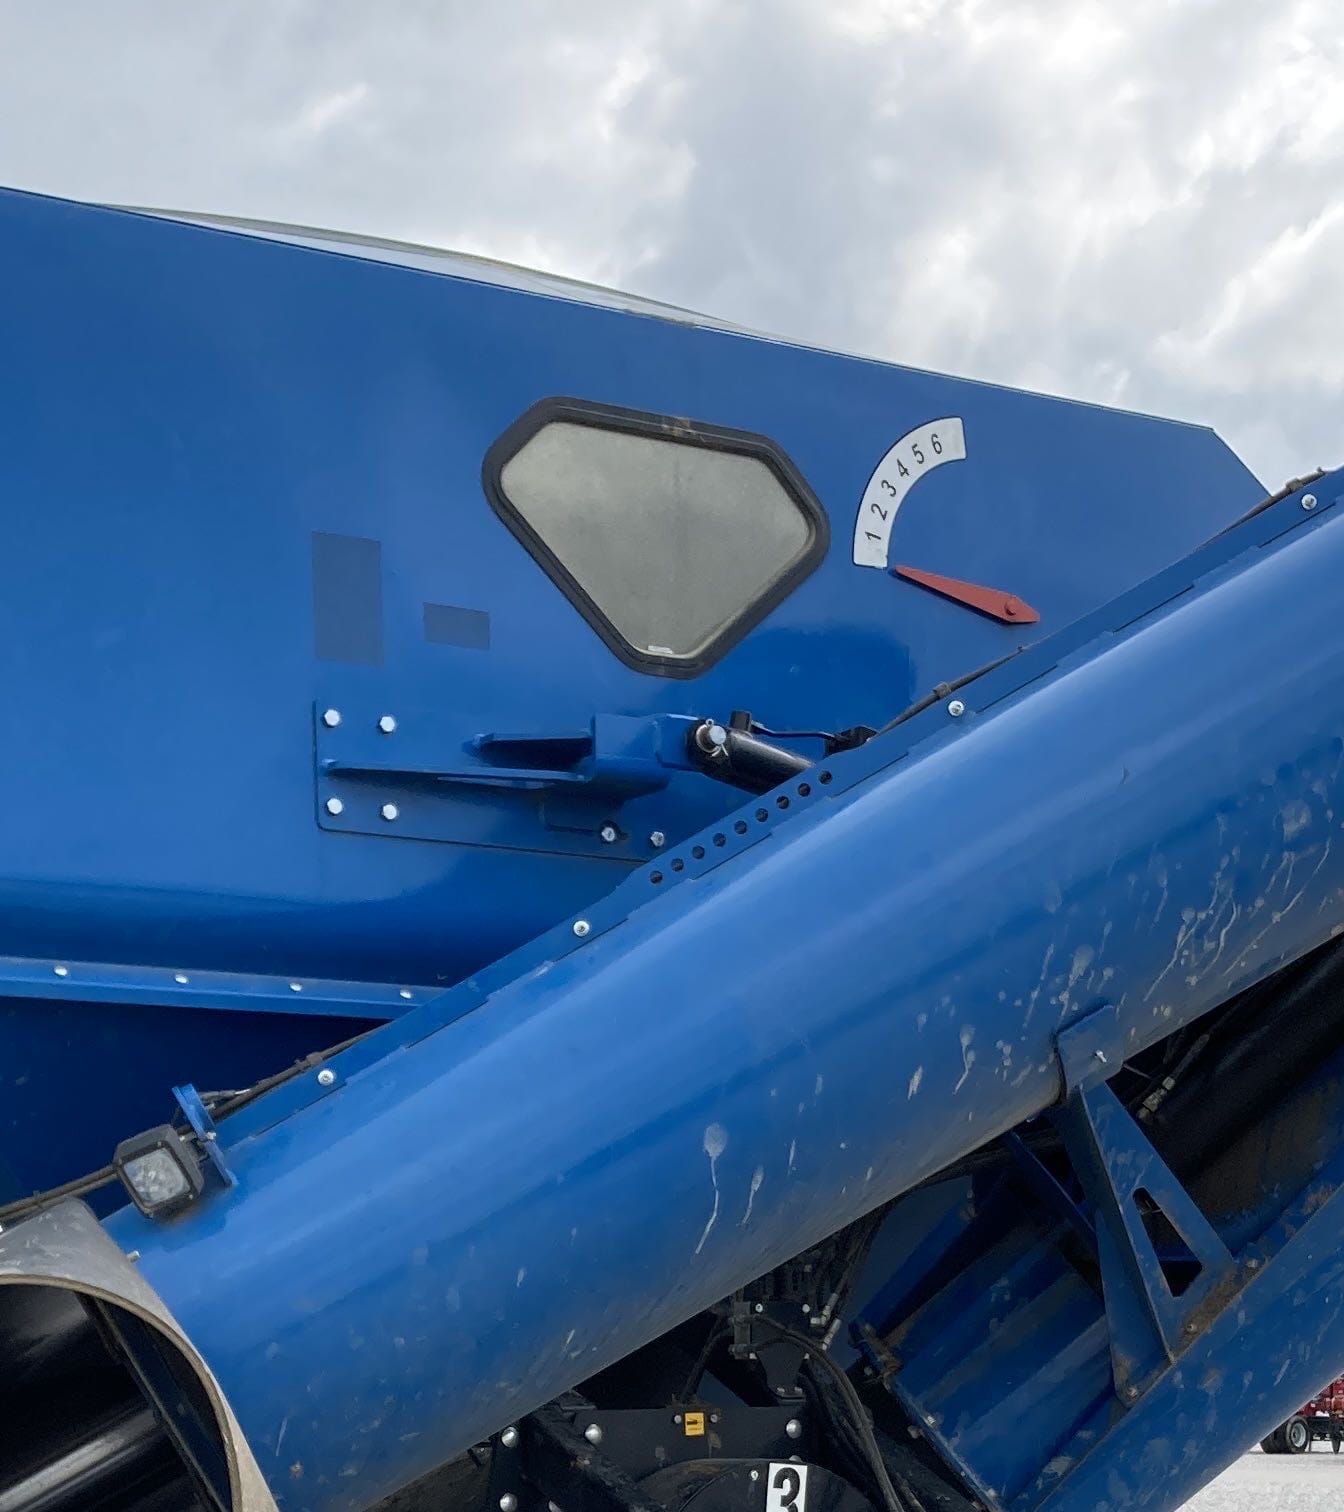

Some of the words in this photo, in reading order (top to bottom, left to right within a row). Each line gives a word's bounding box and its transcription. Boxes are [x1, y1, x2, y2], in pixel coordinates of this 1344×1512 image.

[931, 433, 943, 455] 6
[911, 443, 925, 464] 5
[896, 458, 910, 477] 4
[881, 480, 897, 497] 3
[871, 503, 888, 521] 2
[865, 531, 882, 541] 1
